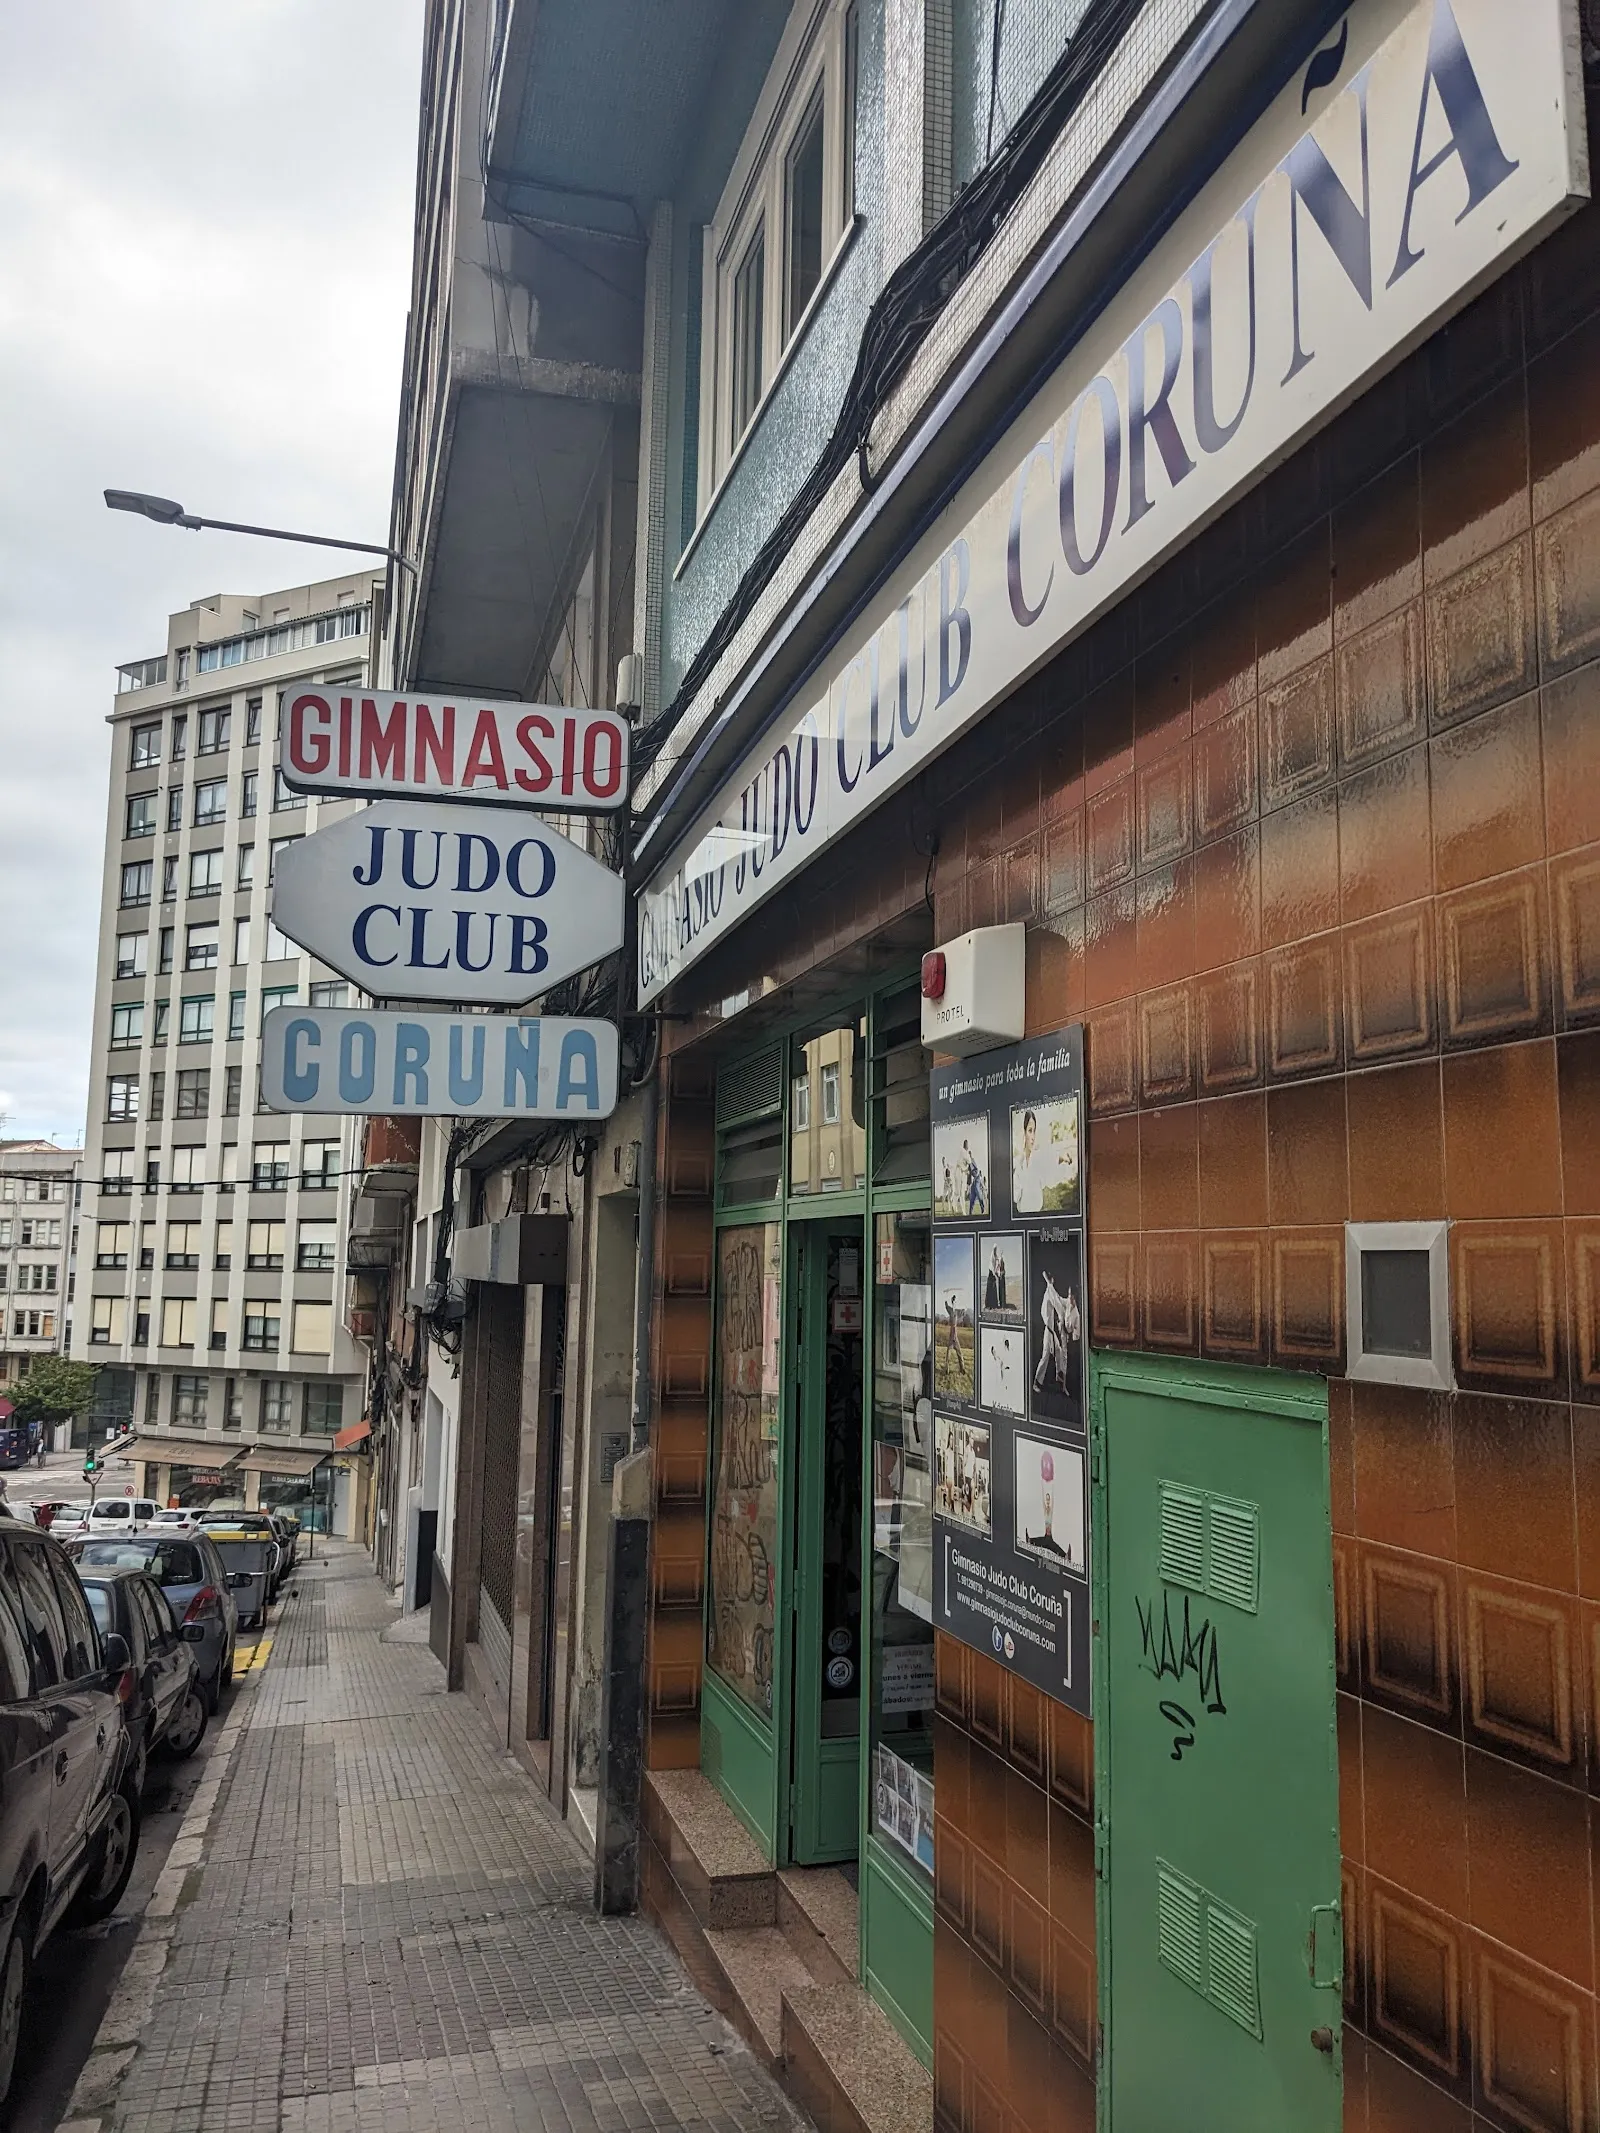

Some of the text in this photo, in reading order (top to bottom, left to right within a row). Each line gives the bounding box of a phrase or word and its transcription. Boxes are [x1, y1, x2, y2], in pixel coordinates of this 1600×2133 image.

[641, 0, 1520, 989] GNASIO JUDO CLUB CORUÑA
[290, 694, 622, 799] GIMNASIO
[353, 825, 556, 898] JUDO
[352, 904, 549, 974] CLUB
[936, 1005, 965, 1024] PROTEL
[283, 1017, 600, 1110] CORUÑA
[938, 1048, 1071, 1103] un gimnasio para toda la familia
[952, 1548, 1063, 1617] Gimnasio Judo Club Coruña
